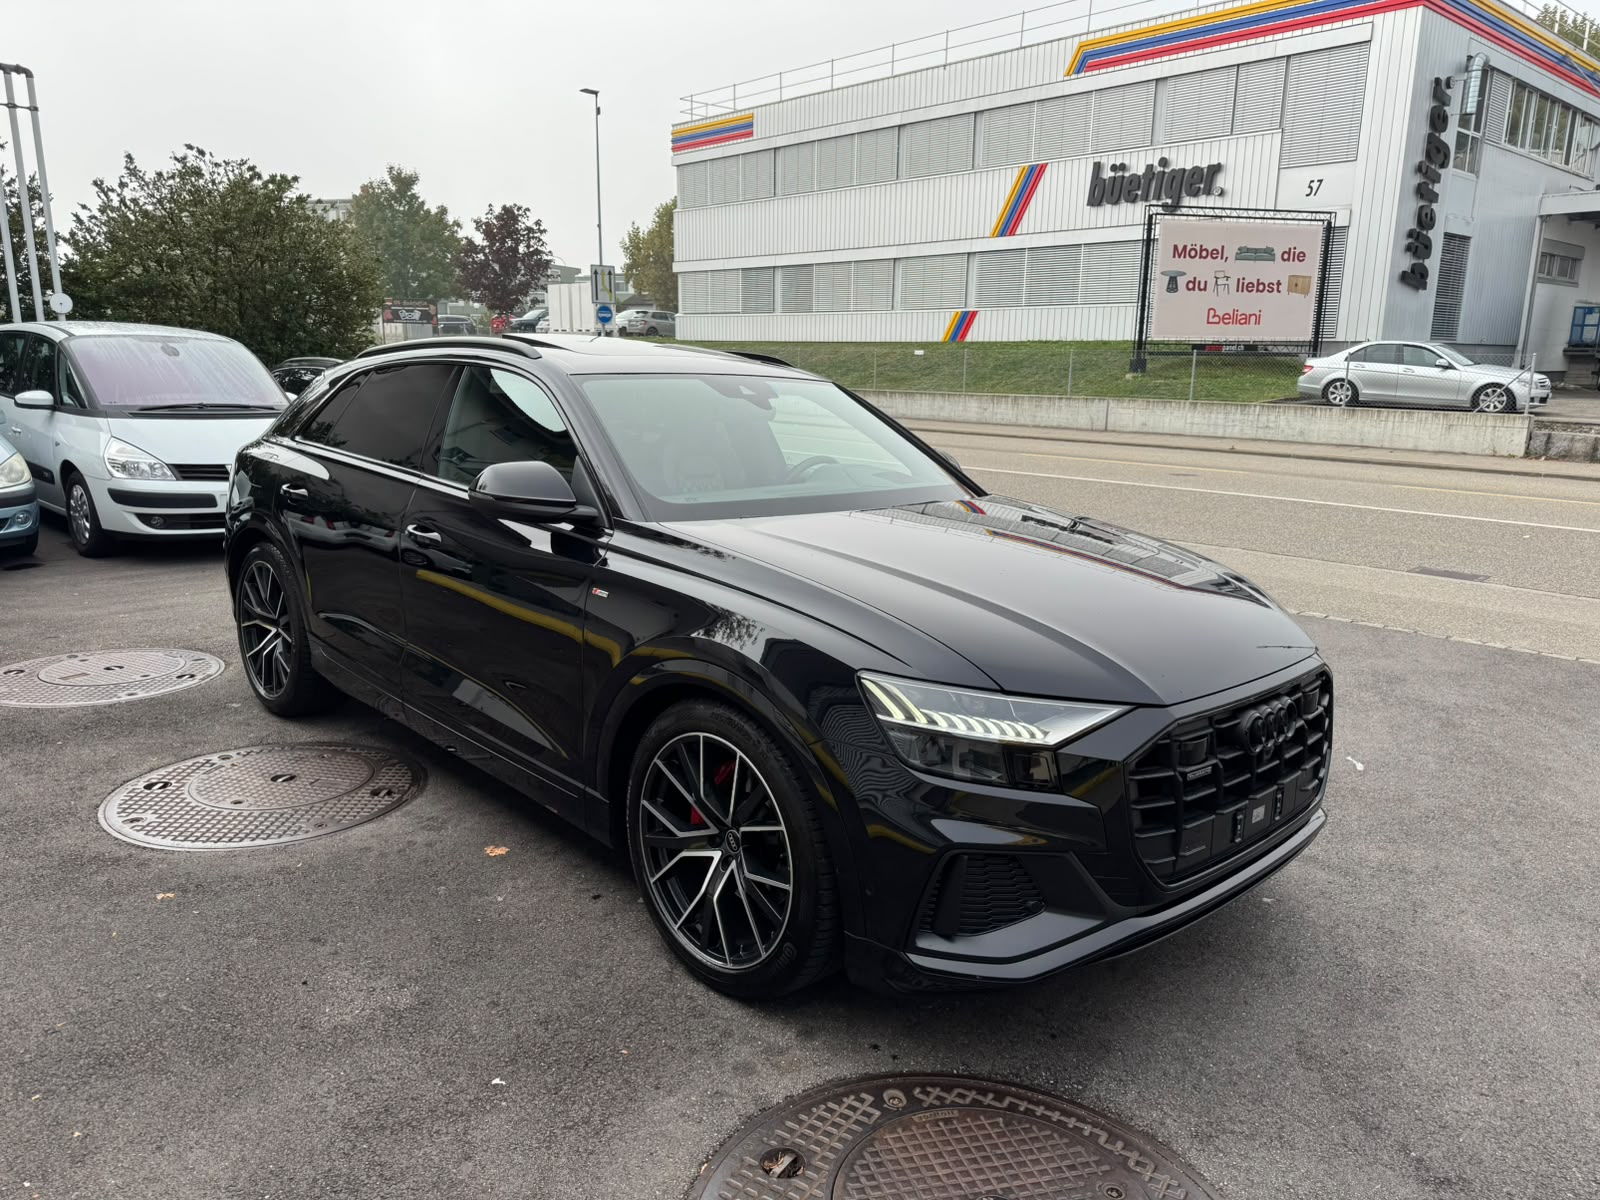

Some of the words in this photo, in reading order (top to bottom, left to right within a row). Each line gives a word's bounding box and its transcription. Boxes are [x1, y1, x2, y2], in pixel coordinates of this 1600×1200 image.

[1305, 179, 1324, 197] 57
[1172, 243, 1229, 262] Möbel,
[1280, 247, 1306, 262] die
[1185, 277, 1208, 292] du
[1235, 277, 1282, 294] liebst
[1206, 307, 1262, 325] Beliani
